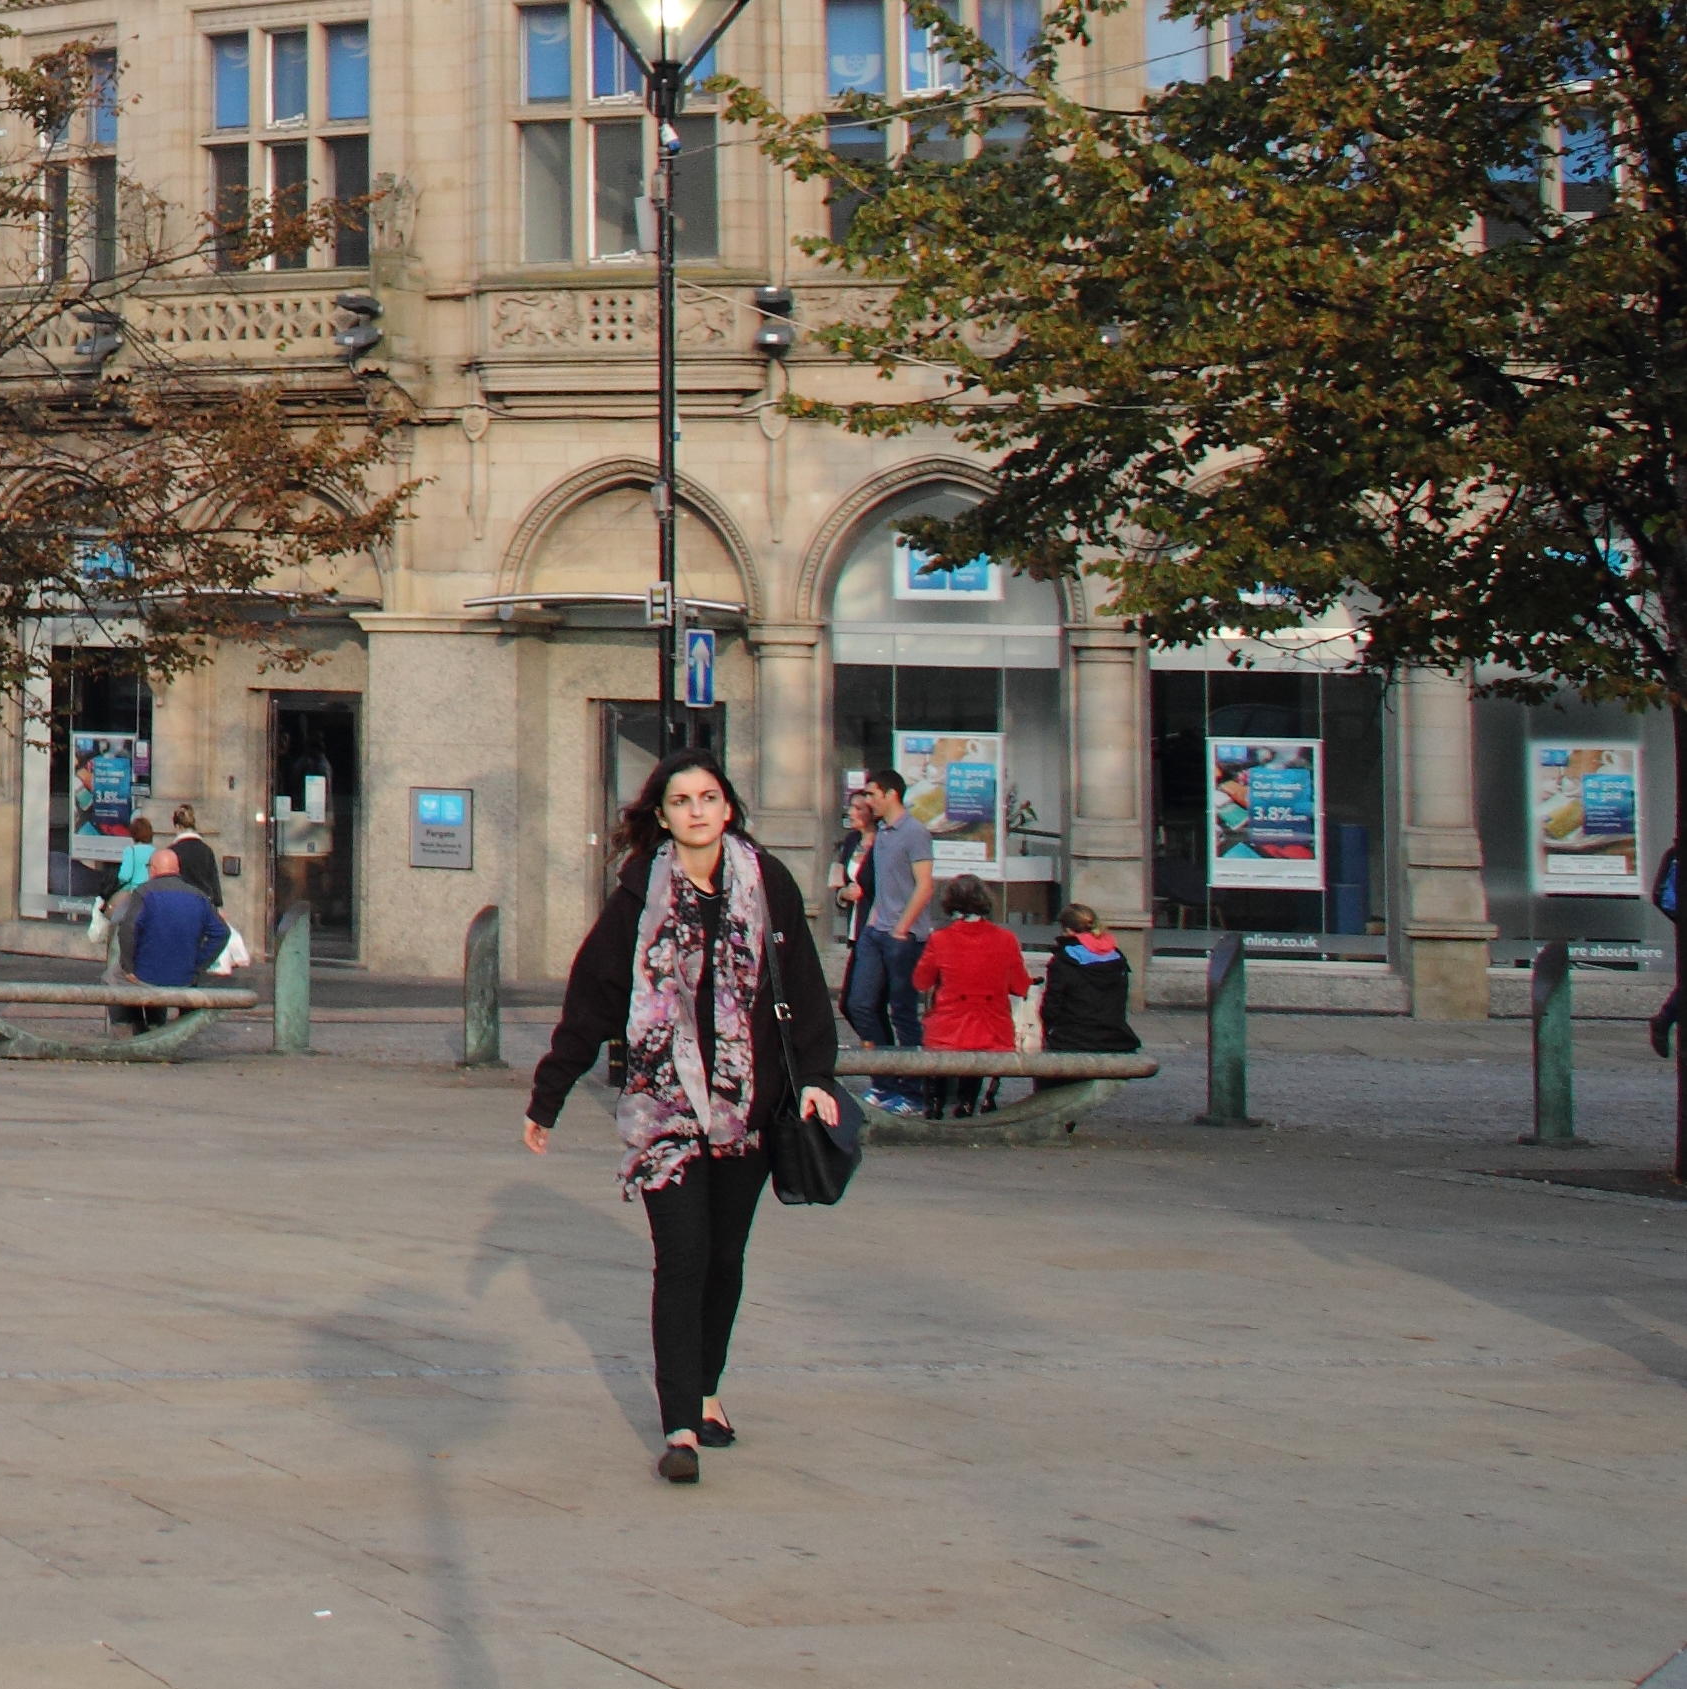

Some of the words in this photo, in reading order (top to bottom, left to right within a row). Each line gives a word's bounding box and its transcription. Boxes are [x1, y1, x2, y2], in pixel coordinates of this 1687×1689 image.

[965, 769, 991, 779] good
[961, 778, 984, 789] gold
[95, 790, 119, 803] 3.8%
[1253, 806, 1293, 821] 3.8%
[1243, 933, 1319, 948] nline.co.uk
[1590, 944, 1629, 957] about
[1631, 945, 1663, 958] here
